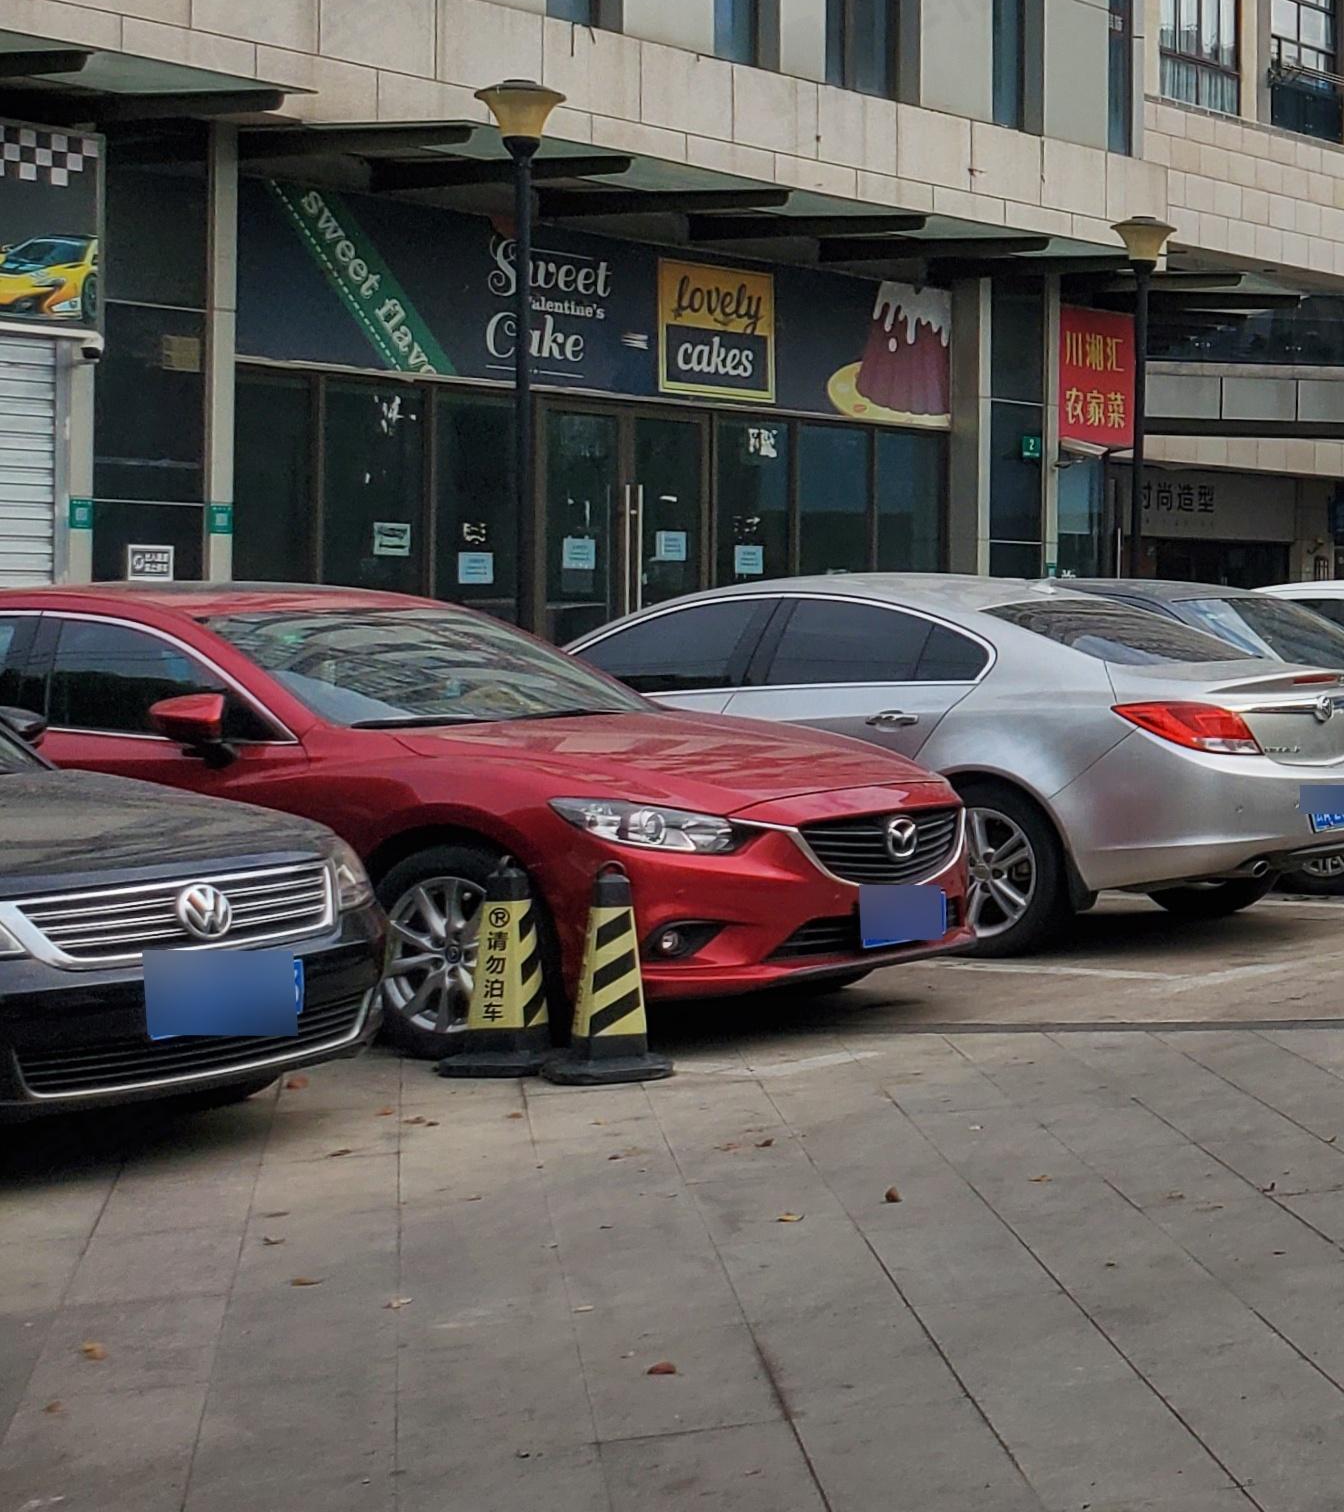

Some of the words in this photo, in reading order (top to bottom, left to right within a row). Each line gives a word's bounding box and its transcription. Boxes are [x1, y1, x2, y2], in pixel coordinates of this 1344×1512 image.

[302, 190, 382, 299] sweet
[488, 235, 613, 298] Sweet
[528, 295, 606, 320] alentine's
[672, 275, 765, 335] lovely
[677, 336, 754, 377] cakes
[1065, 331, 1125, 372] 川湘汇
[1065, 387, 1126, 429] 农家菜
[482, 932, 509, 1022] 请勿泊车
